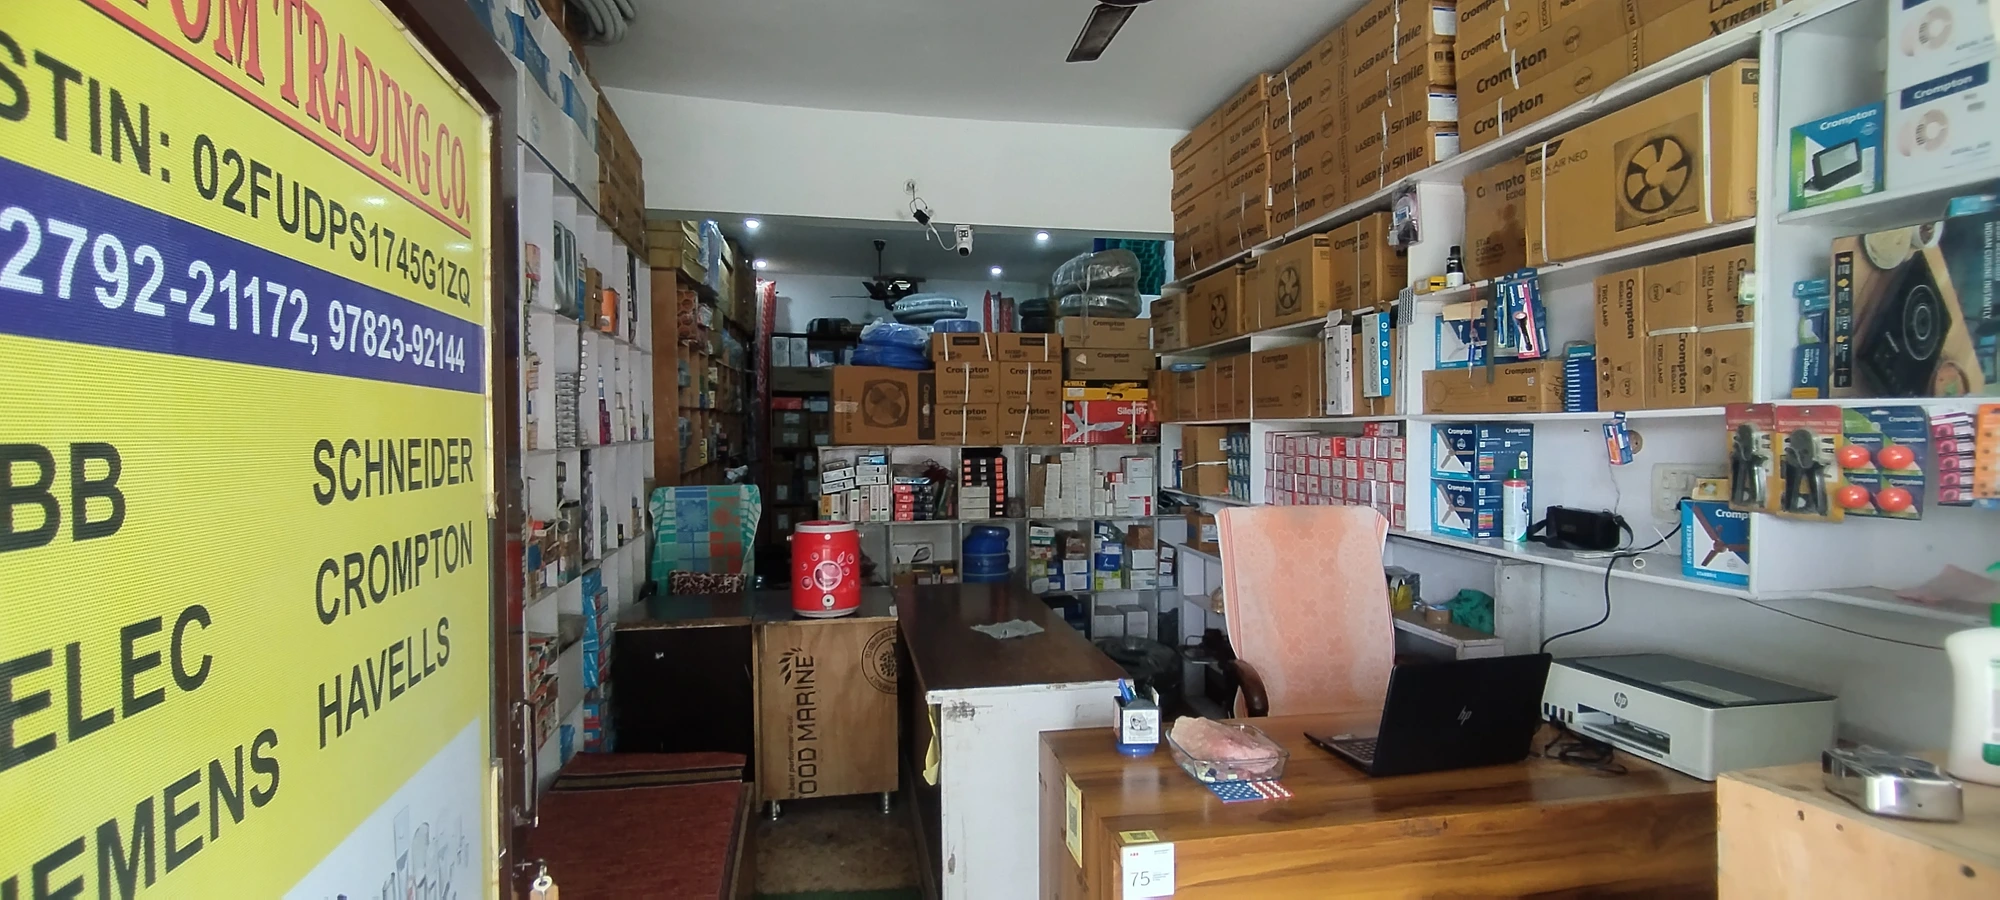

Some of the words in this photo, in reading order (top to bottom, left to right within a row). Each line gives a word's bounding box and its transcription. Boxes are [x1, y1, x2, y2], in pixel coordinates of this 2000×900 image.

[1355, 15, 1377, 37] LASER
[1377, 4, 1392, 21] RAY
[1353, 57, 1374, 78] LASER
[1375, 46, 1390, 63] RAY
[1476, 47, 1547, 94] Crompton
[1356, 94, 1377, 114] LASER
[1393, 64, 1424, 91] Smile
[1913, 75, 1973, 99] Crompton
[272, 0, 431, 196] TRADING
[436, 123, 471, 224] CO.
[1473, 93, 1544, 135] Crompton
[1820, 109, 1877, 130] Crompton
[1275, 130, 1315, 161] Crompton
[1355, 132, 1375, 154] LASER
[1391, 110, 1422, 134] Smile
[1356, 170, 1377, 188] LASER
[1392, 146, 1423, 169] Smile
[1568, 149, 1589, 164] NEO
[193, 134, 471, 307] 02FUDPS1745G1ZQ
[1984, 222, 1993, 248] INDIAN
[1334, 231, 1369, 250] Crompon
[1983, 249, 1993, 279] CUISINE
[1625, 278, 1635, 339] Crompton
[1706, 288, 1714, 313] LAMP
[1983, 280, 1993, 319] INSTANTLY
[328, 305, 465, 374] 97823-92144
[1504, 366, 1536, 376] Crompton
[1728, 373, 1736, 391] 12W
[1802, 348, 1810, 384] Crompton
[312, 437, 475, 505] SCHNEIDER
[1447, 484, 1472, 492] Crompton
[1715, 508, 1750, 521] Cromp
[315, 521, 474, 625] CROMPTON
[0, 604, 213, 772] ELEC
[317, 616, 451, 749] HAVELLS
[794, 655, 817, 741] MARINE
[1614, 692, 1628, 709] hp
[1457, 706, 1472, 726] hp
[798, 747, 818, 799] OOD
[0, 728, 280, 900] MENS
[1131, 870, 1151, 887] 75
